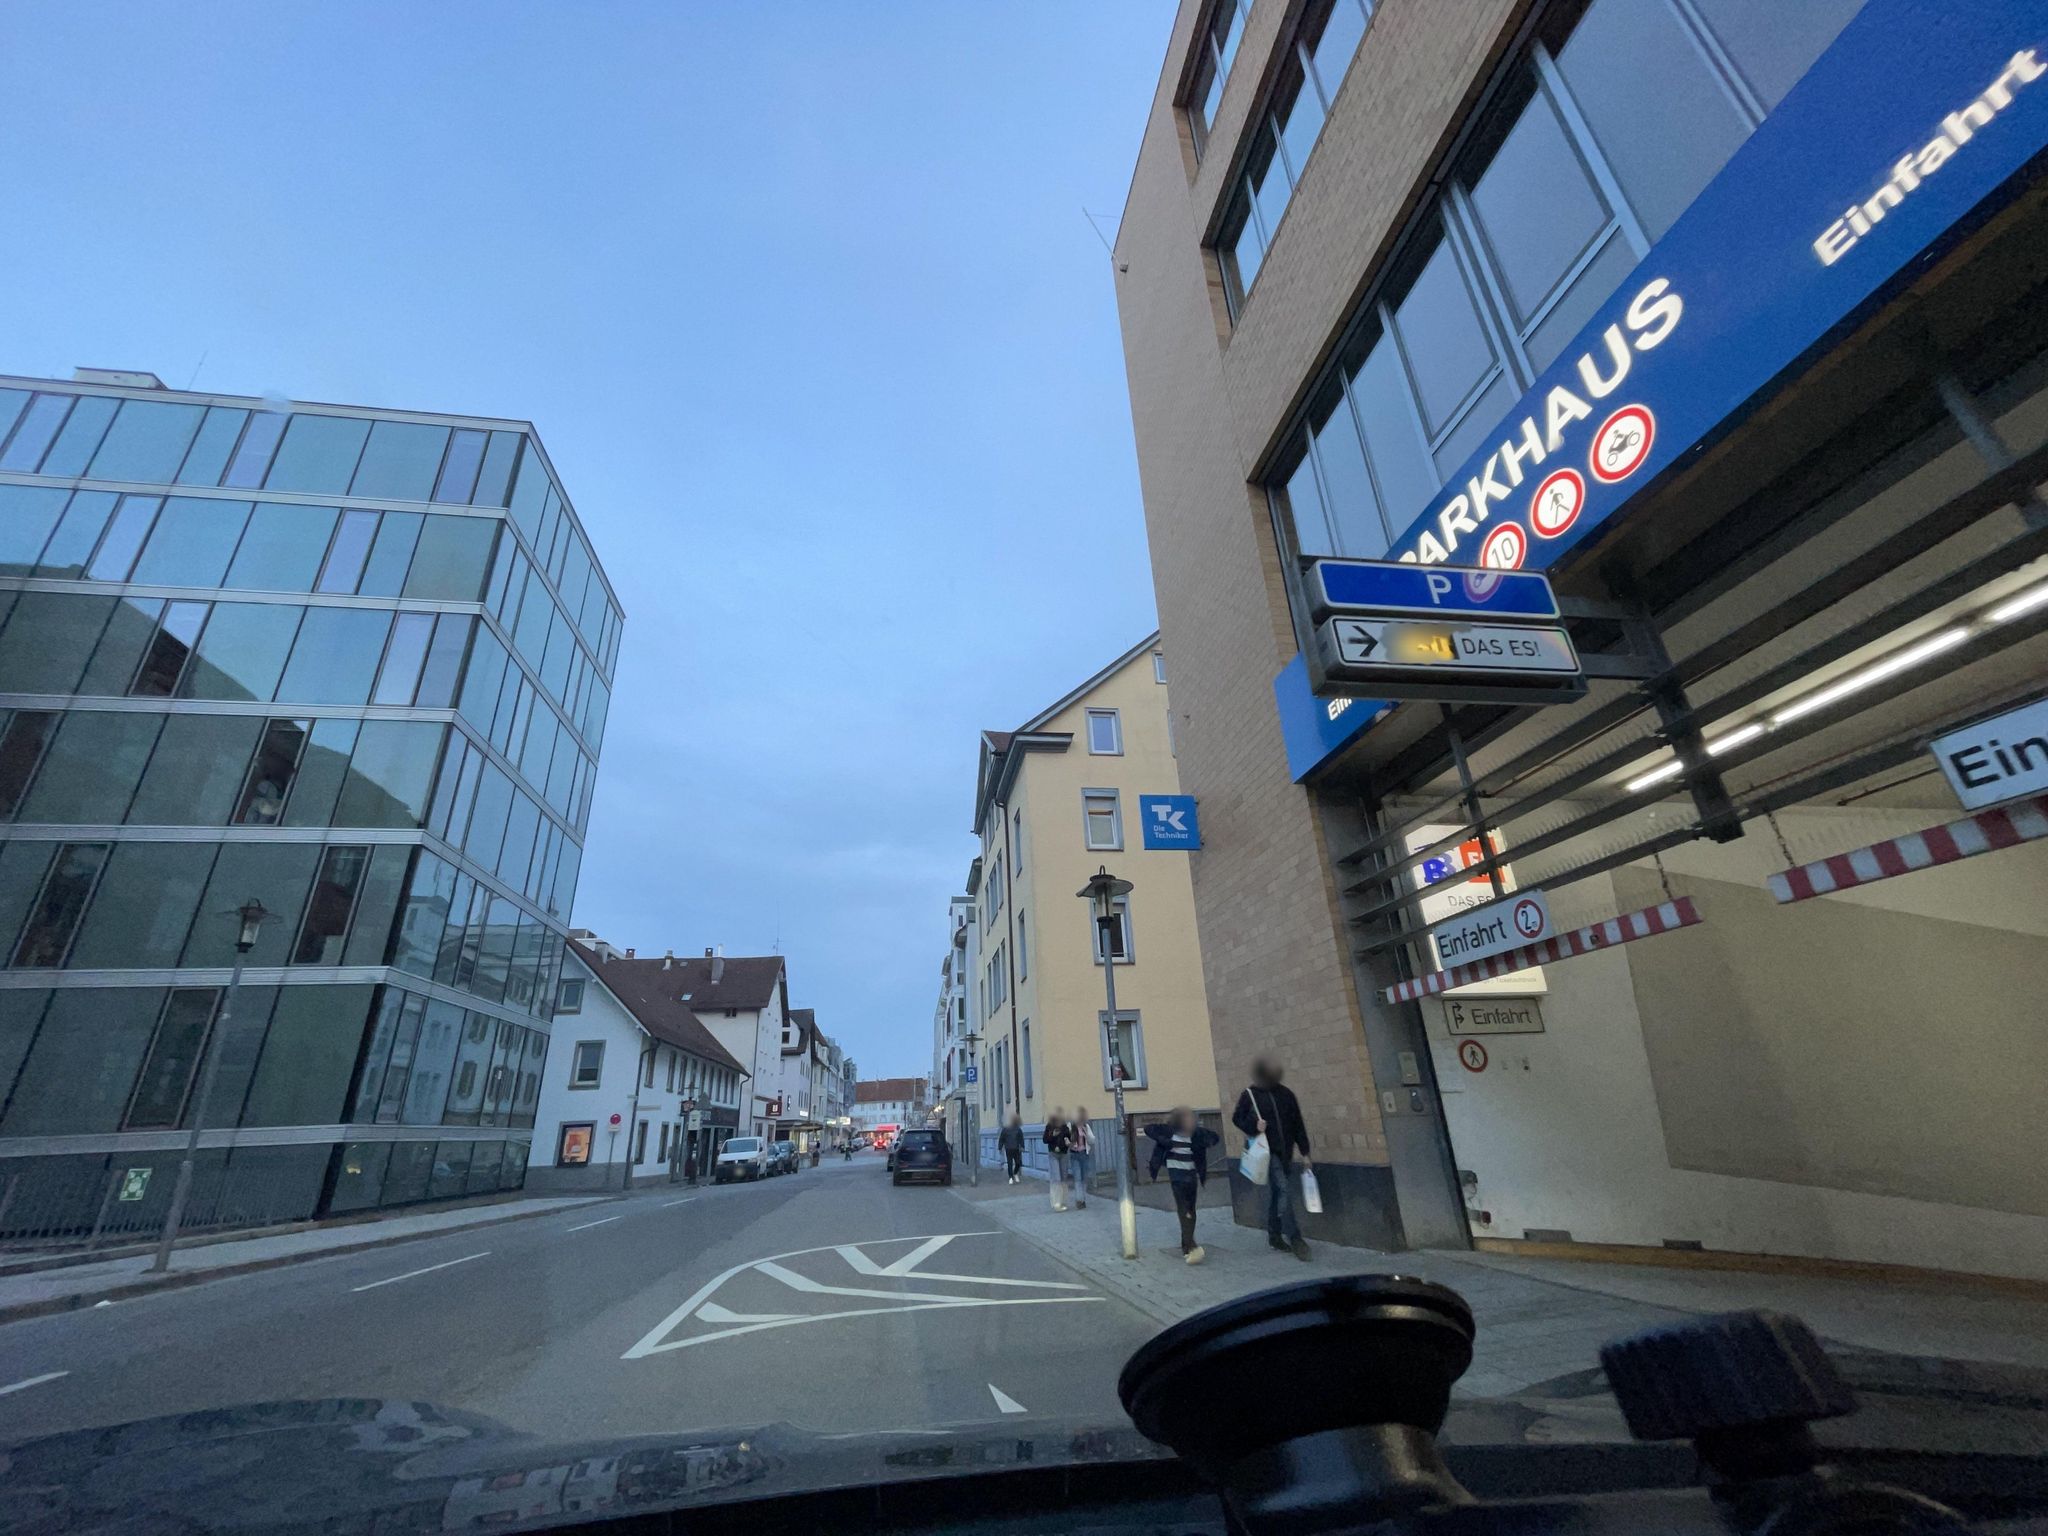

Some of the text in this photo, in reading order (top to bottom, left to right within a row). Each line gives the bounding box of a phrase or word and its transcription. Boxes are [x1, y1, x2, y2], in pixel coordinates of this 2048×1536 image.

[1813, 49, 2048, 267] Einfahrt
[1491, 537, 1515, 568] 10
[1427, 574, 1452, 604] P
[1460, 637, 1504, 656] DAS
[1508, 639, 1542, 657] ES!
[1151, 804, 1188, 831] TK
[1447, 895, 1477, 907] DAS
[1521, 910, 1532, 930] 2
[1437, 917, 1508, 959] Einfahrt
[1471, 1008, 1532, 1025] Einfahrt
